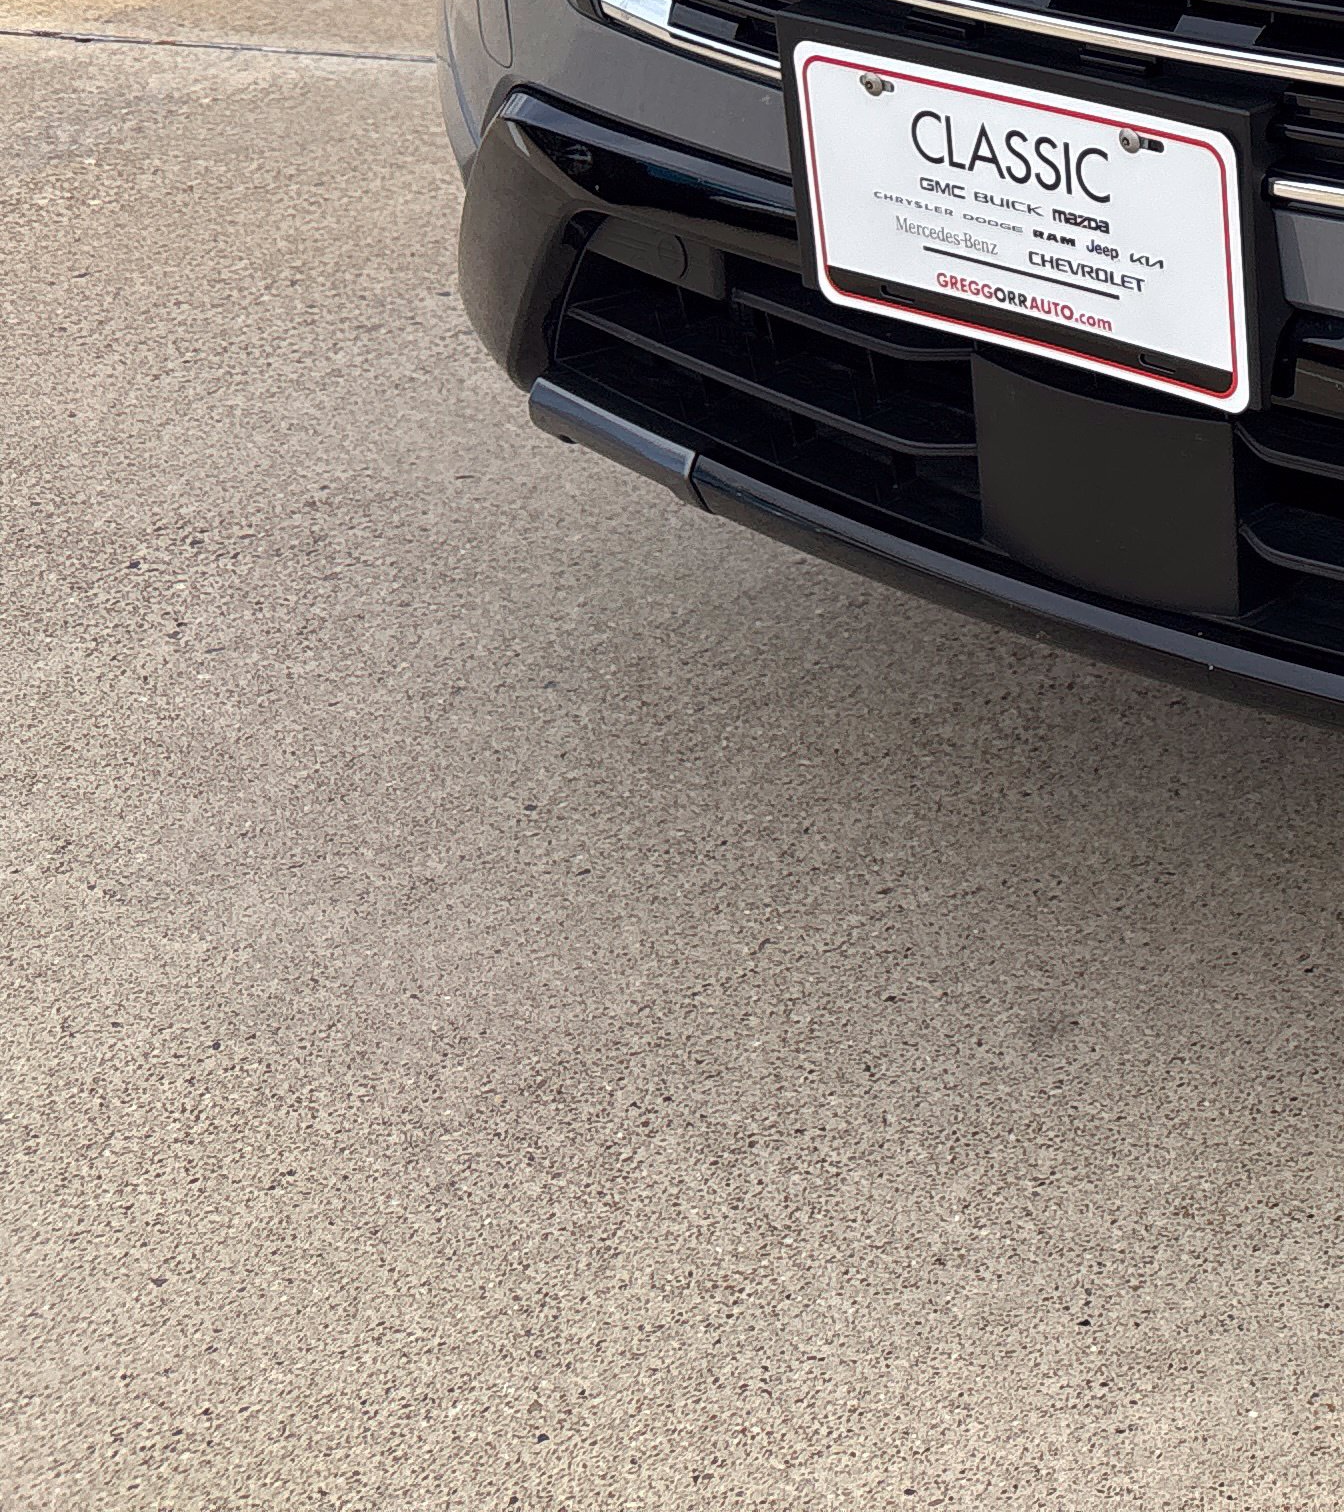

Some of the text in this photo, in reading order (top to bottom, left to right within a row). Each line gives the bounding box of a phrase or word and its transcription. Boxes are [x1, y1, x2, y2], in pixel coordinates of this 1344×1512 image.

[911, 110, 1111, 203] CLASSIC
[874, 191, 954, 217] CHRYSLER
[963, 213, 1023, 233] DODGE
[1032, 228, 1076, 247] RAM
[1086, 239, 1119, 260] Jeep
[919, 176, 966, 200] GMC
[974, 191, 1045, 217] BUICK
[895, 215, 1145, 292] Mercedes-Benz CHEVROLET
[936, 272, 1112, 332] GREGGORRAUTO.com
